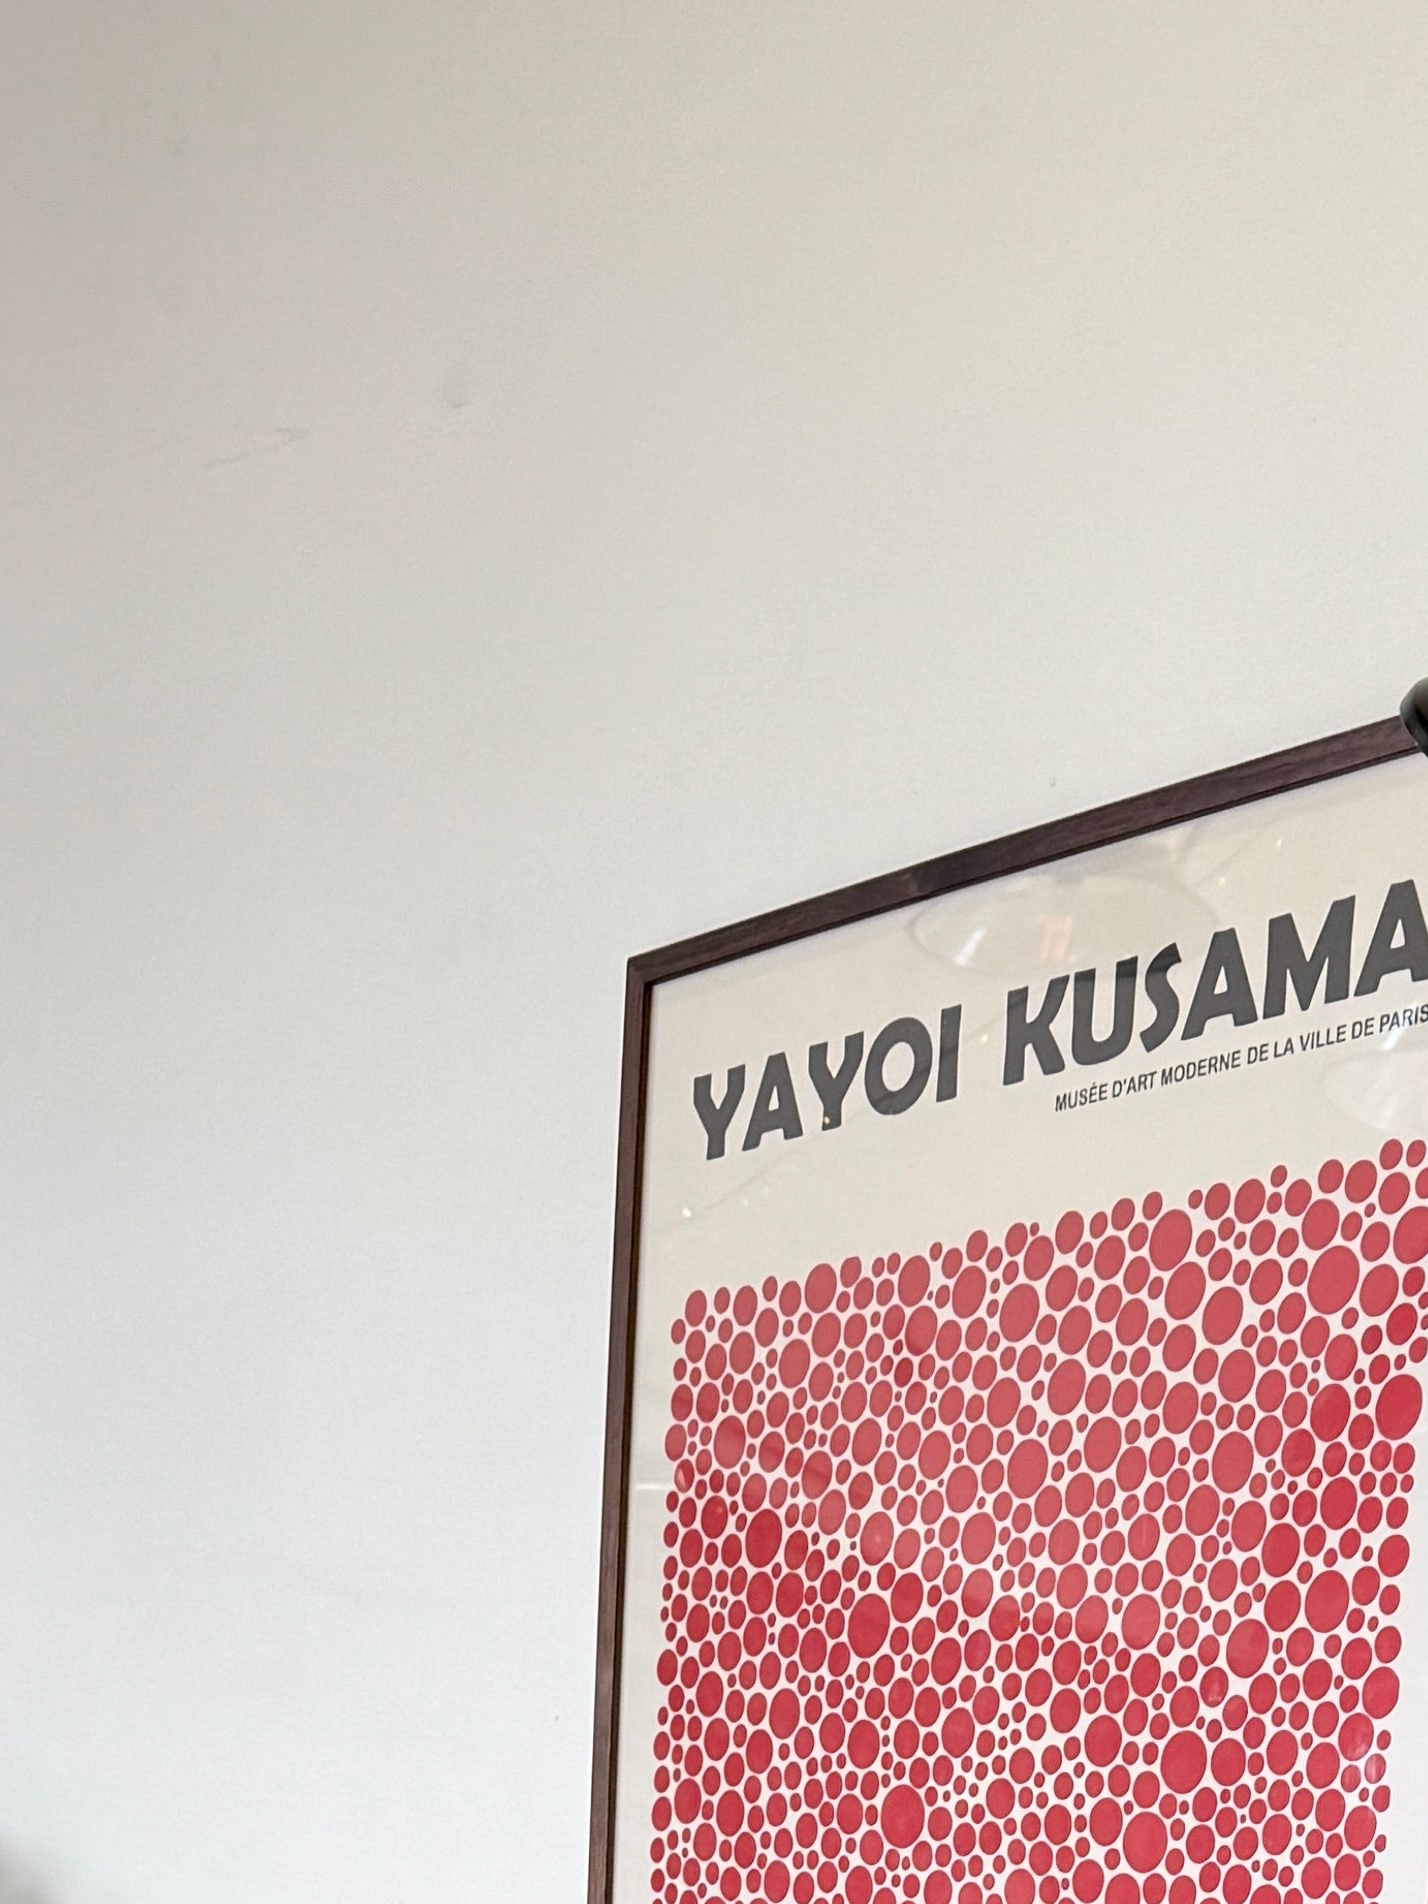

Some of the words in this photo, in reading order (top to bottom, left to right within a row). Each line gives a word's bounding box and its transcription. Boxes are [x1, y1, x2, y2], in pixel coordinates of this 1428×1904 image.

[693, 1004, 962, 1161] YAYOI
[1054, 1081, 1109, 1112] MUSÉE
[1112, 1071, 1159, 1099] D'ART
[1160, 1050, 1242, 1086] MODERNE
[1247, 1043, 1270, 1065] DE
[1273, 1037, 1295, 1058] LA
[1299, 1024, 1348, 1053] VILLE
[1351, 1017, 1376, 1041] DE
